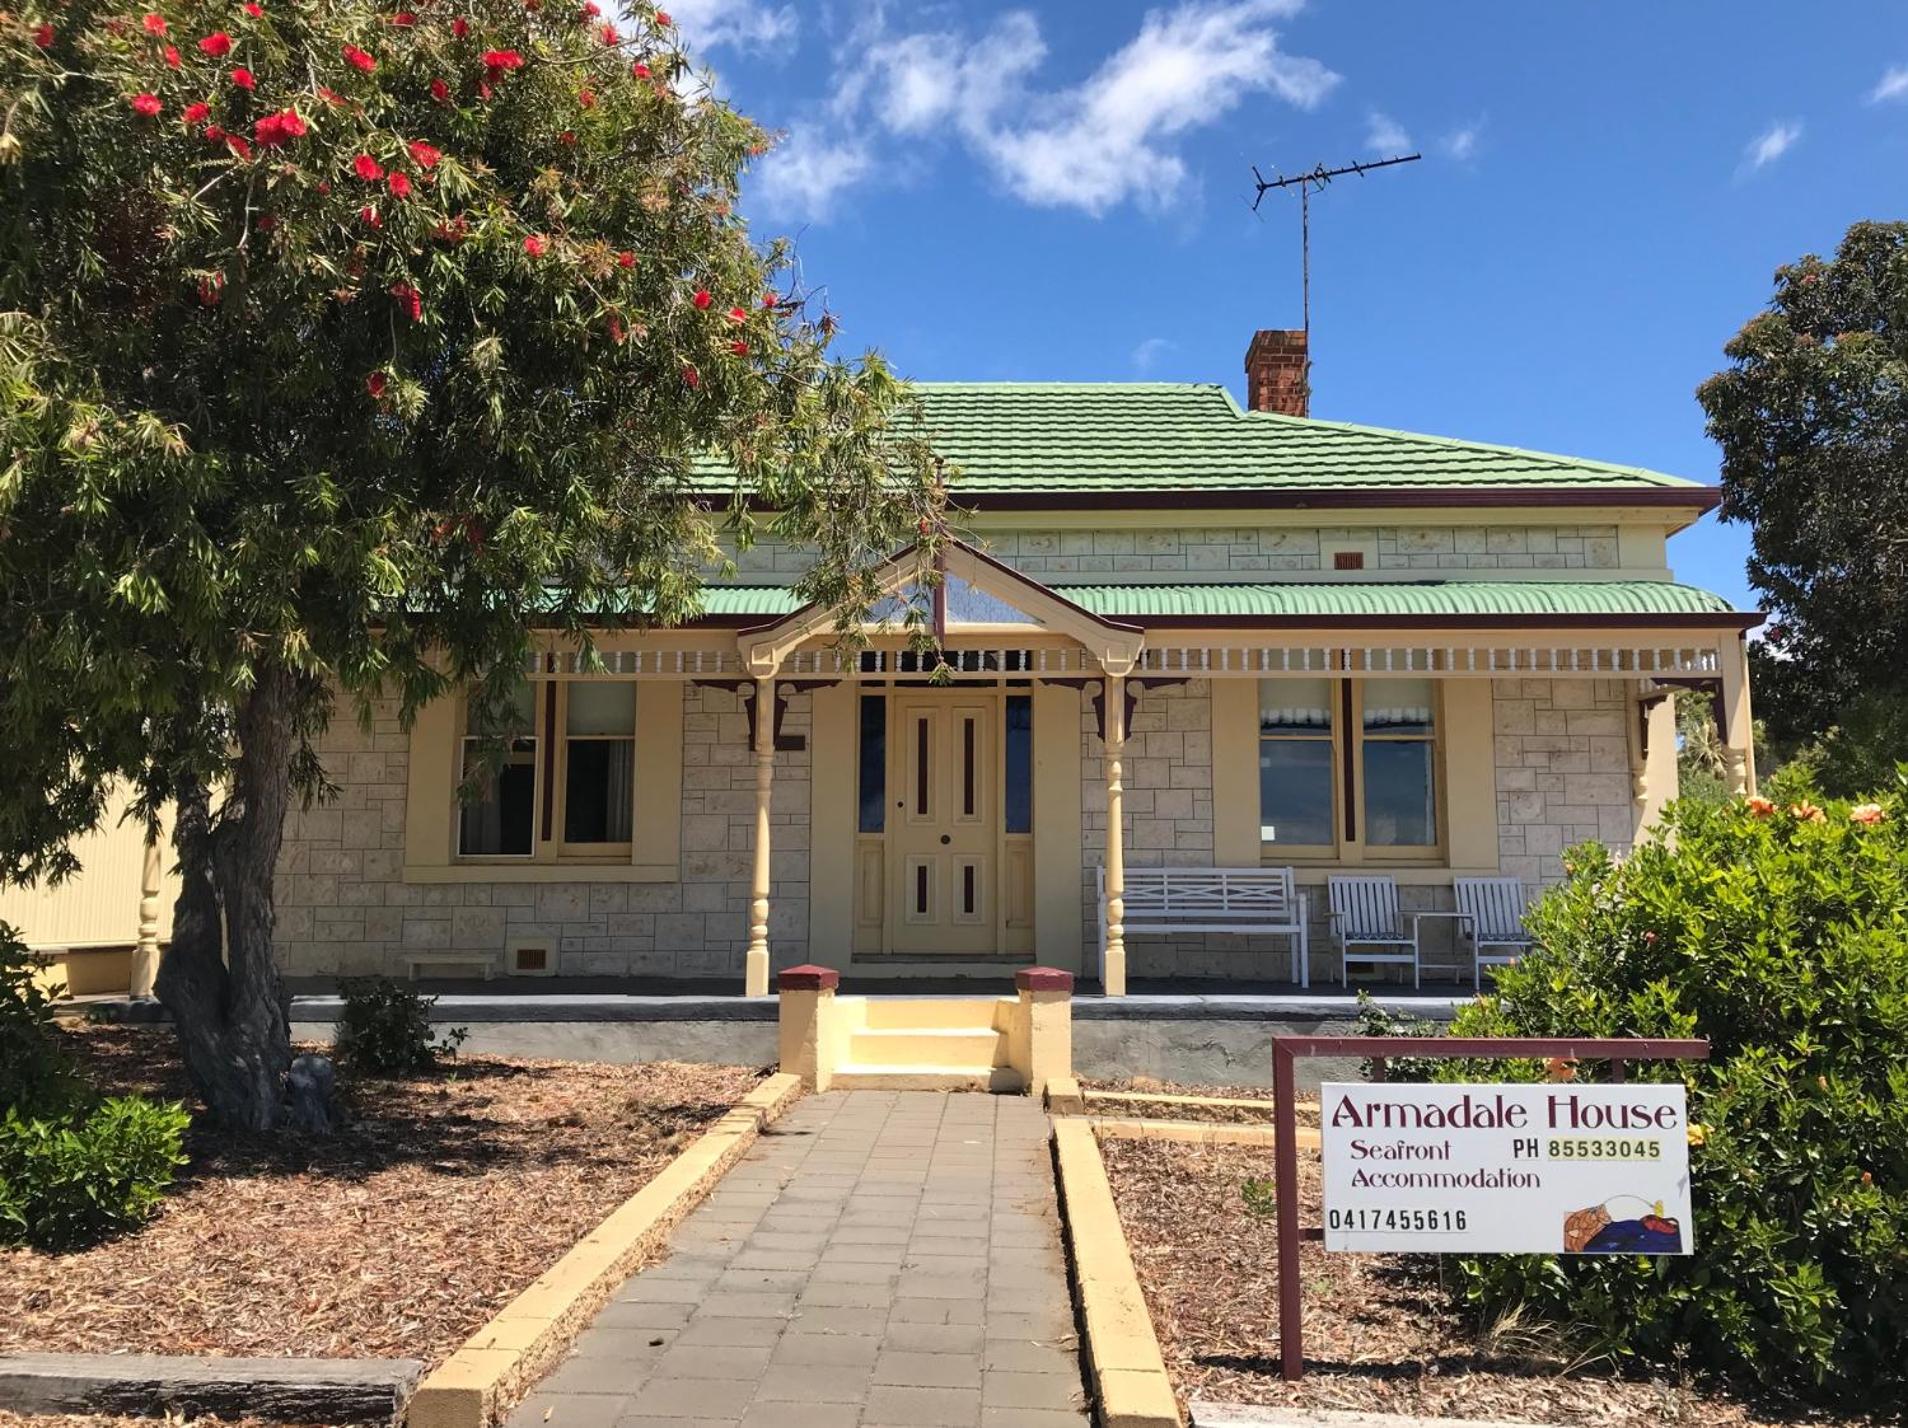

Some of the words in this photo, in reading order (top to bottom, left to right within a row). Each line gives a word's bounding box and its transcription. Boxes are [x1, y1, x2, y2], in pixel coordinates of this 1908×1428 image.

[1331, 1094, 1528, 1129] Armadale
[1548, 1095, 1678, 1129] House
[1350, 1139, 1452, 1161] Seafront
[1513, 1138, 1539, 1158] PH
[1548, 1140, 1661, 1158] 85533045
[1351, 1168, 1541, 1188] Accommodation
[1329, 1209, 1467, 1230] 0417455616
